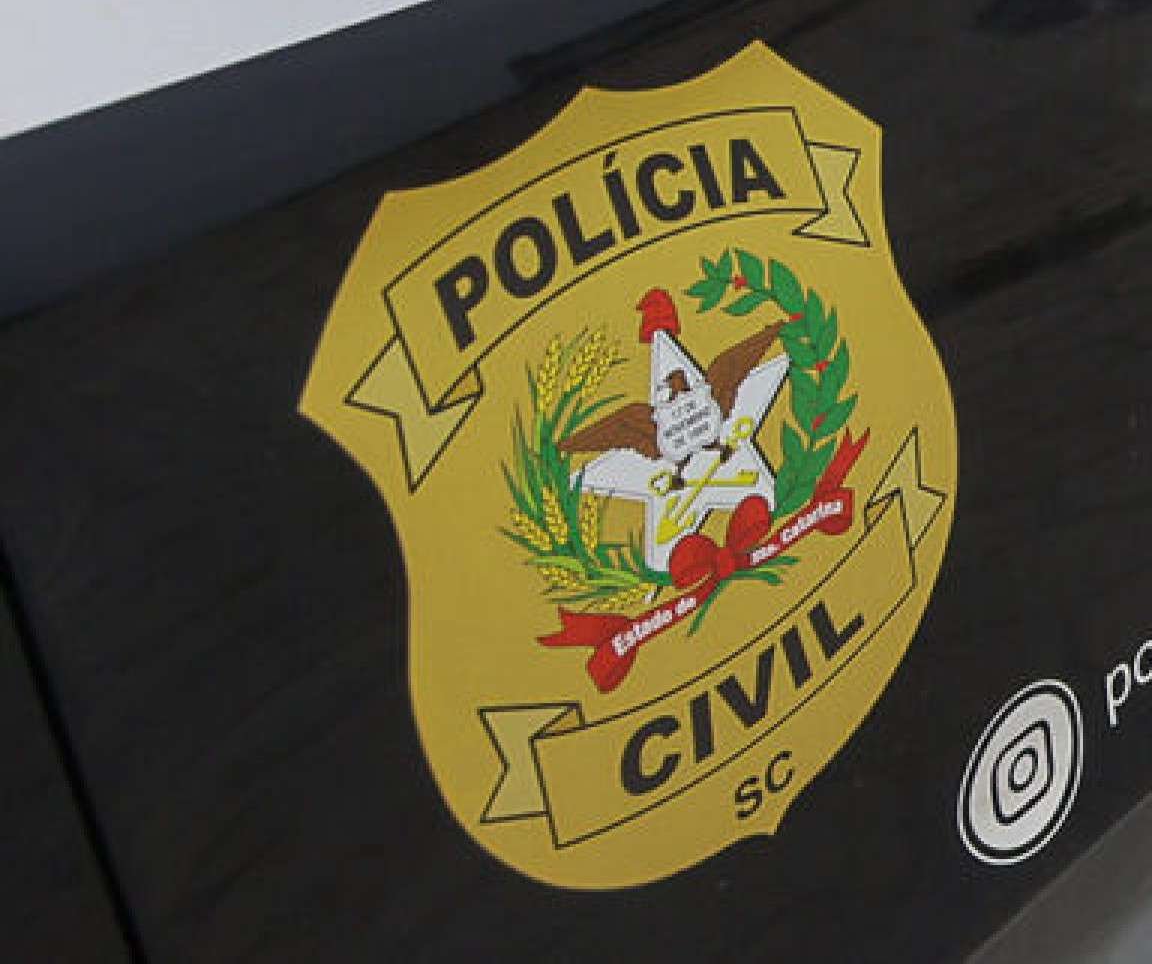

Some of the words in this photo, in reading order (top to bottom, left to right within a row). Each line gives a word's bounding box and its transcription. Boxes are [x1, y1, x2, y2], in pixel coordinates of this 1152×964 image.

[434, 136, 786, 351] POLÍCIA
[612, 609, 673, 656] Estado
[674, 597, 697, 616] de
[620, 599, 865, 797] CIVIL
[734, 748, 796, 820] SC
